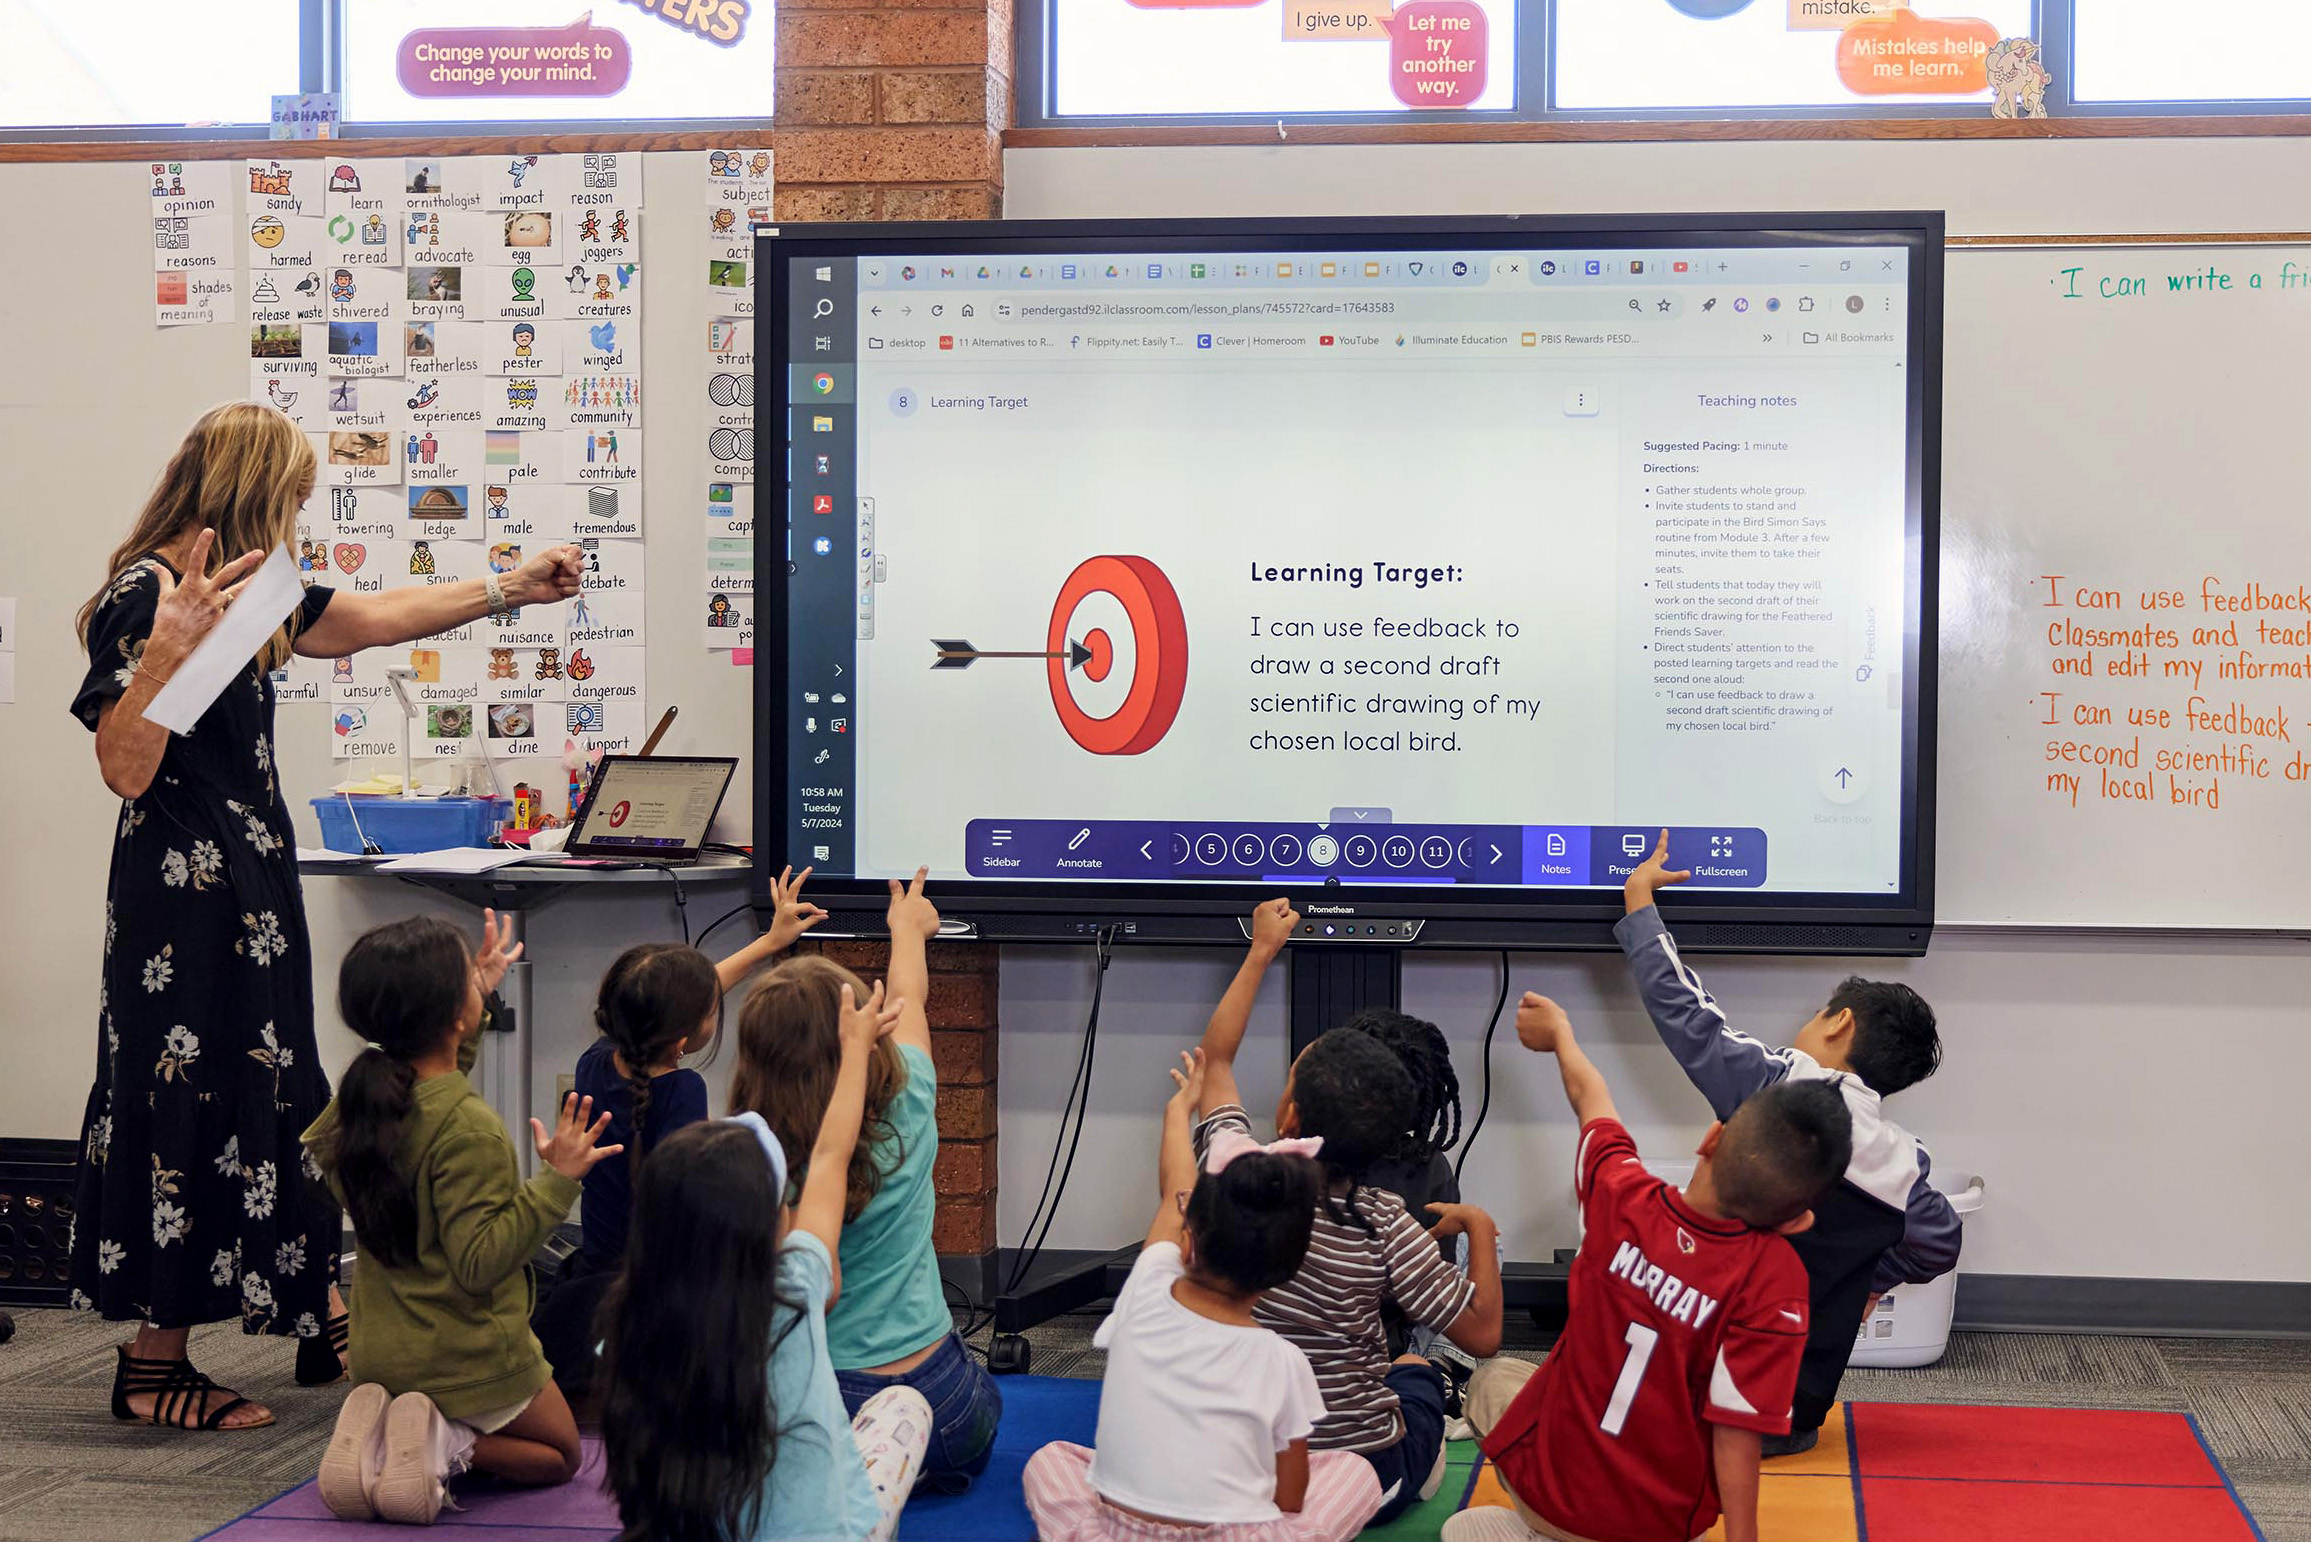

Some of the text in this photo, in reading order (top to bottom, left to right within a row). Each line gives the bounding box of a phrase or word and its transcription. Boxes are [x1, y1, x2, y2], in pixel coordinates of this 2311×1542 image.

[1802, 0, 1876, 15] mistake.
[644, 0, 745, 41] ERS
[1297, 12, 1372, 32] I give up.
[1409, 15, 1471, 30] Let me
[415, 42, 612, 63] Change your words to
[1426, 36, 1452, 55] try
[1853, 37, 1986, 58] Mistakes help
[1403, 56, 1475, 73] another
[1874, 59, 1964, 76] me learn.
[429, 63, 597, 84] change your mind.
[1417, 79, 1459, 95] way.
[272, 110, 338, 123] GABHART
[350, 196, 382, 210] learn
[406, 194, 481, 210] ornithologist
[500, 190, 544, 208] impact
[571, 192, 613, 204] reason
[722, 187, 770, 205] subject
[164, 198, 214, 216] opinion
[266, 196, 302, 216] sandy
[166, 256, 216, 267] reasons
[270, 252, 312, 266] harmed
[342, 252, 387, 264] reread
[414, 250, 474, 263] advocate
[512, 252, 531, 264] egg
[581, 246, 623, 262] joggers
[192, 280, 232, 294] shades
[2100, 277, 2146, 298] can
[2168, 266, 2233, 290] write
[2250, 272, 2262, 289] a
[199, 296, 210, 308] of
[500, 300, 544, 318] unusual
[161, 310, 213, 322] meaning
[252, 307, 323, 321] release waste
[332, 303, 389, 318] shivered
[412, 302, 464, 318] braying
[578, 304, 631, 316] creatures
[889, 338, 926, 350] desktop
[1216, 336, 1306, 346] Clever Homeroom
[1339, 336, 1379, 345] YouTube
[1412, 335, 1508, 345] Illuminate Education
[1826, 332, 1894, 342] All Bookmarks
[329, 356, 373, 369] aquatic
[410, 358, 478, 373] featherless
[502, 356, 543, 373] pester
[583, 349, 623, 372] winged
[263, 360, 318, 377] surviving
[345, 363, 390, 376] biologist
[900, 396, 1028, 411] 8 Learning Target
[1698, 394, 1796, 408] Teaching notes
[336, 411, 386, 425] wetsuit
[414, 411, 481, 428] experiences
[496, 412, 546, 430] amazing
[570, 410, 632, 426] community
[1644, 441, 1788, 452] Suggested Pacing: 1 minute
[344, 467, 376, 484] glide
[411, 464, 458, 479] smaller
[508, 464, 538, 484] pale
[579, 466, 637, 479] contribute
[1643, 463, 1698, 473] Directions:
[337, 522, 394, 539] towering
[424, 522, 456, 539] ledge
[504, 522, 533, 534] male
[573, 522, 636, 534] tremendous
[581, 576, 626, 588] debate
[1251, 562, 1463, 589] Learning Target:
[354, 575, 382, 592] heal
[2041, 576, 2311, 613] I can use feedback
[1251, 616, 1520, 637] I can use feedback to
[2193, 620, 2239, 646] and
[499, 632, 554, 644] nuisance
[570, 626, 634, 645] pedestrian
[1250, 655, 1500, 675] draw a second draft
[2052, 650, 2093, 677] and
[2108, 650, 2150, 677] edit
[2164, 660, 2202, 690] my
[275, 686, 319, 698] harmful
[344, 686, 392, 698] unsure
[420, 682, 478, 701] damaged
[500, 684, 545, 699] similar
[572, 684, 636, 700] dangerous
[1250, 693, 1540, 721] scientific drawing of my
[2041, 692, 2290, 743] I can use feedback
[344, 741, 396, 756] remove
[508, 741, 538, 754] dine
[1250, 731, 1461, 751] chosen local bird.
[2046, 736, 2138, 768] second
[2155, 743, 2270, 778] scientific
[801, 788, 843, 797] 10:58 AM
[2048, 768, 2219, 809] my local bird
[803, 804, 841, 814] Tuesday
[801, 819, 842, 828] 5/7/2024
[1208, 844, 1443, 857] 5 6 7 8 9 10 11
[983, 857, 1020, 867] Sidebar
[1057, 858, 1102, 868] Annotate
[1541, 865, 1571, 874] Notes
[1695, 866, 1747, 877] Fullscreen
[1308, 905, 1354, 914] Promethean
[1609, 1240, 1717, 1329] MURRAY
[1600, 1321, 1658, 1435] 1
